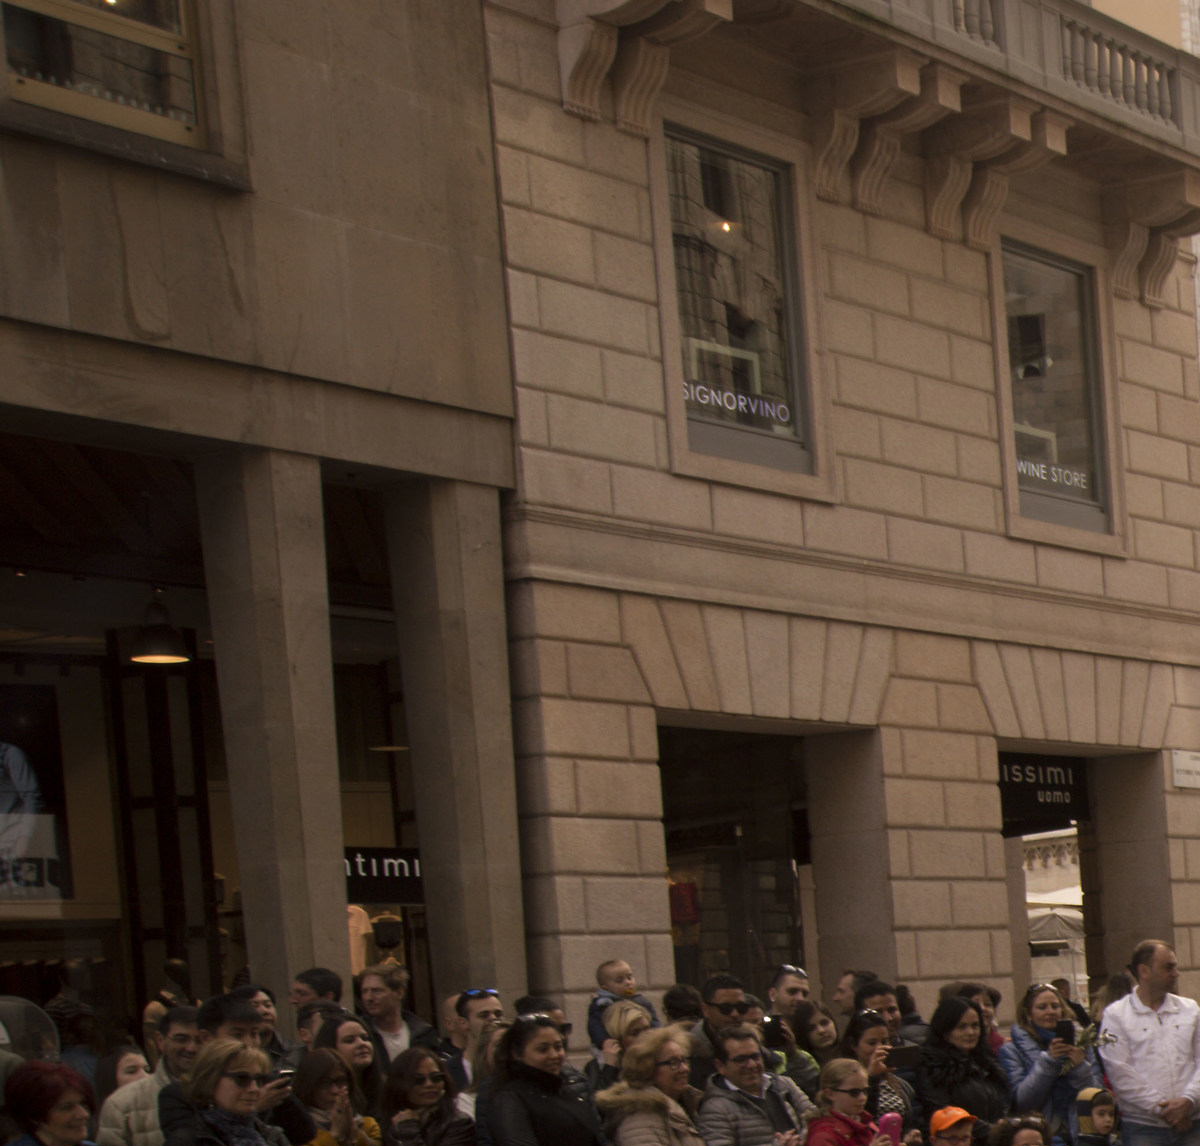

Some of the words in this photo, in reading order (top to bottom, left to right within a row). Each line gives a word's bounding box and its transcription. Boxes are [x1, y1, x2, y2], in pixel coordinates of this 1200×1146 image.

[683, 382, 790, 422] SIGNORVINO
[1016, 459, 1047, 480] WINE
[1051, 466, 1087, 489] STORE
[1037, 791, 1071, 803] uomo
